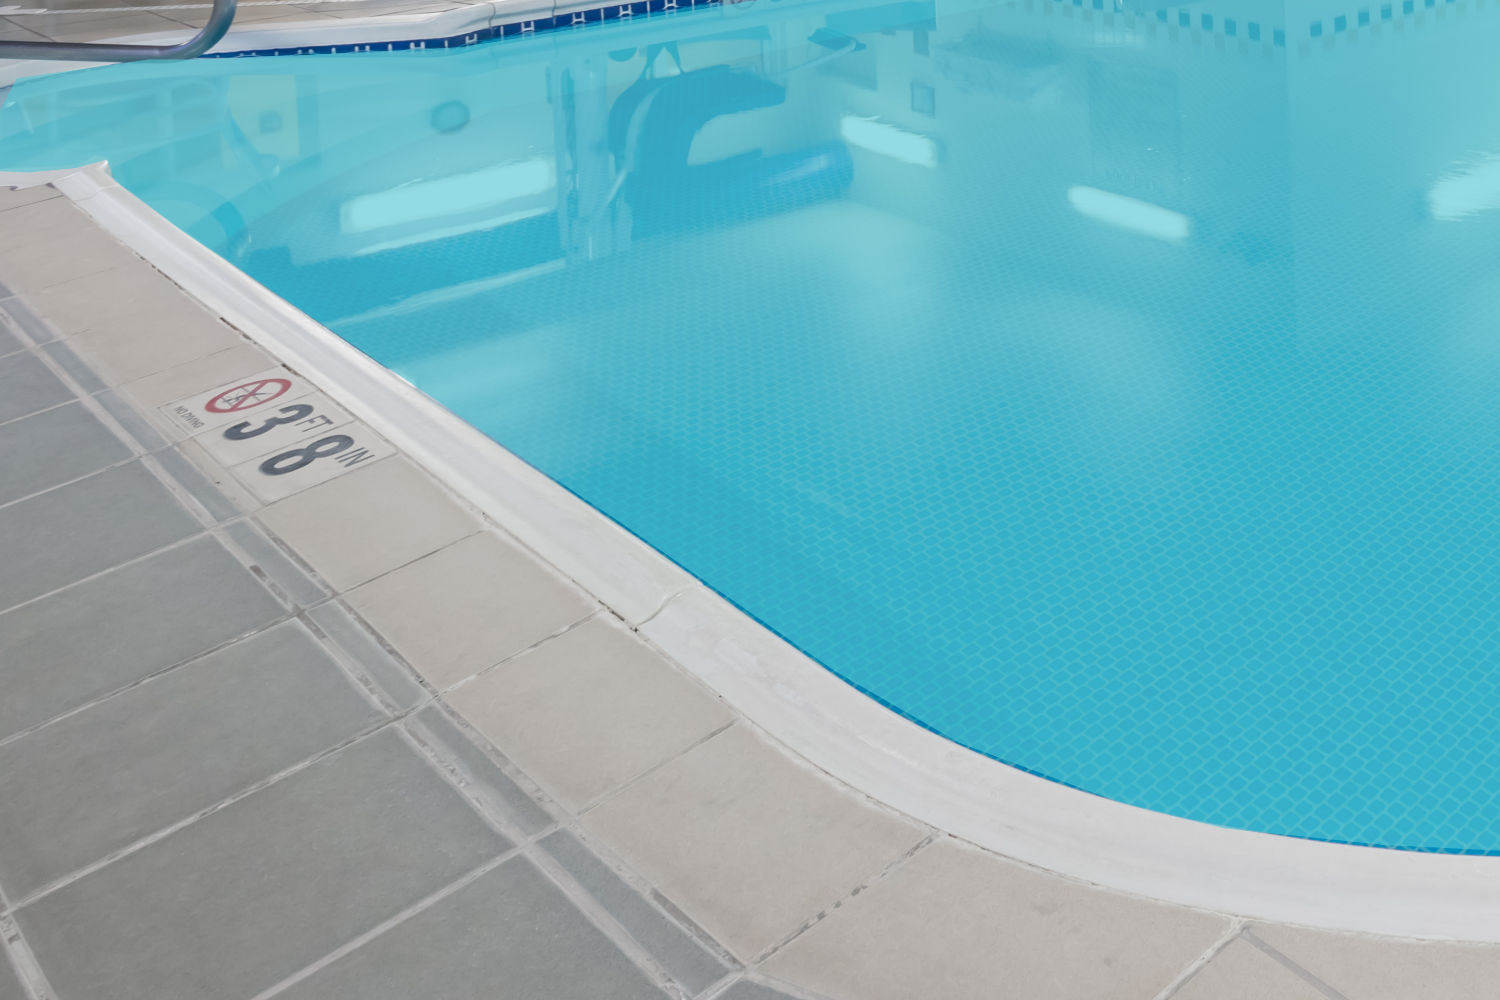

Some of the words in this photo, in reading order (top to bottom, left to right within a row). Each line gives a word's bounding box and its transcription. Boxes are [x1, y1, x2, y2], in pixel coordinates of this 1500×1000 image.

[222, 403, 315, 441] 3
[294, 414, 334, 433] FT
[258, 434, 355, 476] 8
[334, 446, 376, 468] IN
